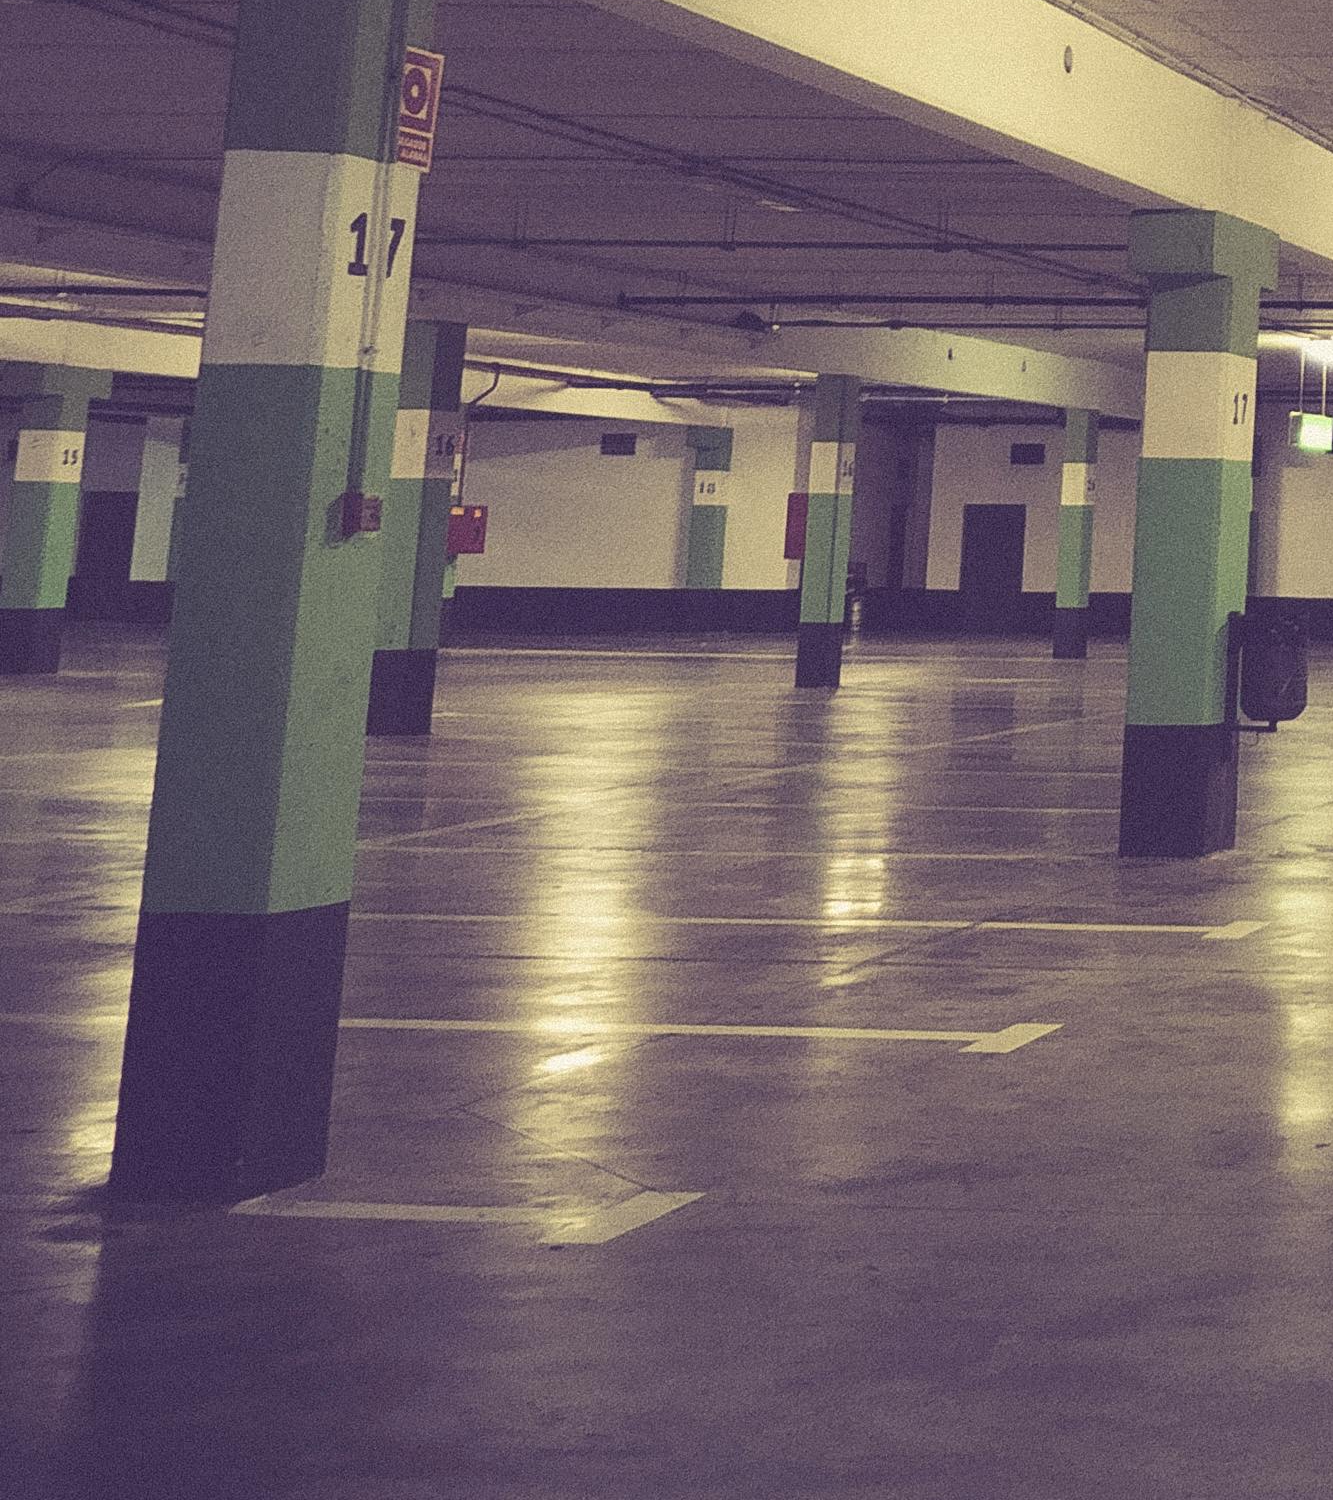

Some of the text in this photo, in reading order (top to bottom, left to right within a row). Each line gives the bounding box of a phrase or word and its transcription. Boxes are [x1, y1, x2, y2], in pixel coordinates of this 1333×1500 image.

[348, 212, 406, 279] 17
[1233, 391, 1248, 425] 17
[62, 448, 79, 466] 15
